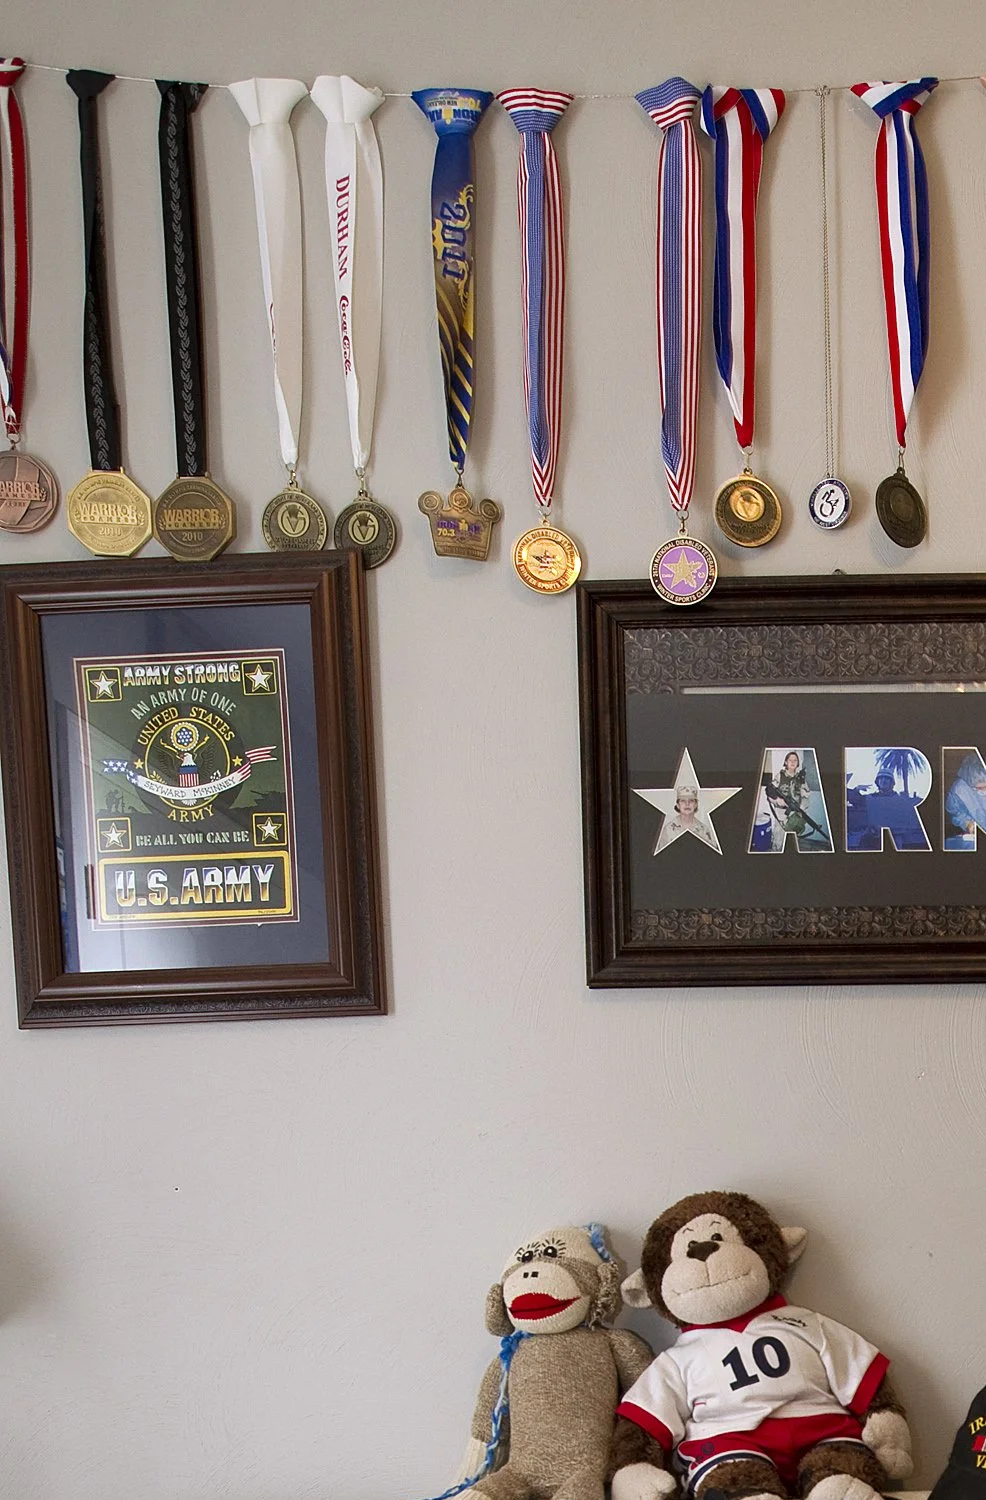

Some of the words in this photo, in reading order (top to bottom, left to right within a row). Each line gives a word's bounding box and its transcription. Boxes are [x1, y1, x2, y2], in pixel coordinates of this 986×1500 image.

[335, 175, 350, 281] DURHAM
[439, 201, 468, 281] 2011
[0, 480, 40, 495] ARRIOR
[79, 502, 137, 518] WARRIOR
[164, 508, 220, 522] WARRIOR
[99, 527, 122, 536] 2010
[181, 531, 204, 542] 2010
[437, 528, 455, 537] 70.3
[654, 542, 676, 562] NATIONAL
[675, 539, 703, 551] DISABLED
[701, 547, 715, 577] VETERANS
[656, 583, 674, 601] WINTER
[674, 594, 697, 603] SPORTS
[696, 582, 711, 598] CLINIC
[123, 664, 170, 687] ARMY
[174, 662, 241, 685] STRONG
[130, 700, 151, 720] AN
[150, 687, 187, 707] ARMY
[191, 687, 208, 703] OF
[210, 692, 237, 717] ONE
[137, 706, 180, 746] UNITED
[189, 706, 236, 742] STATES
[143, 780, 187, 798] SEYWARD
[167, 805, 216, 823] ARMY
[135, 834, 152, 847] BE
[154, 833, 178, 846] ALL
[178, 832, 204, 845] YOU
[206, 831, 230, 844] CAN
[233, 830, 250, 842] BE
[721, 1335, 791, 1392] 10
